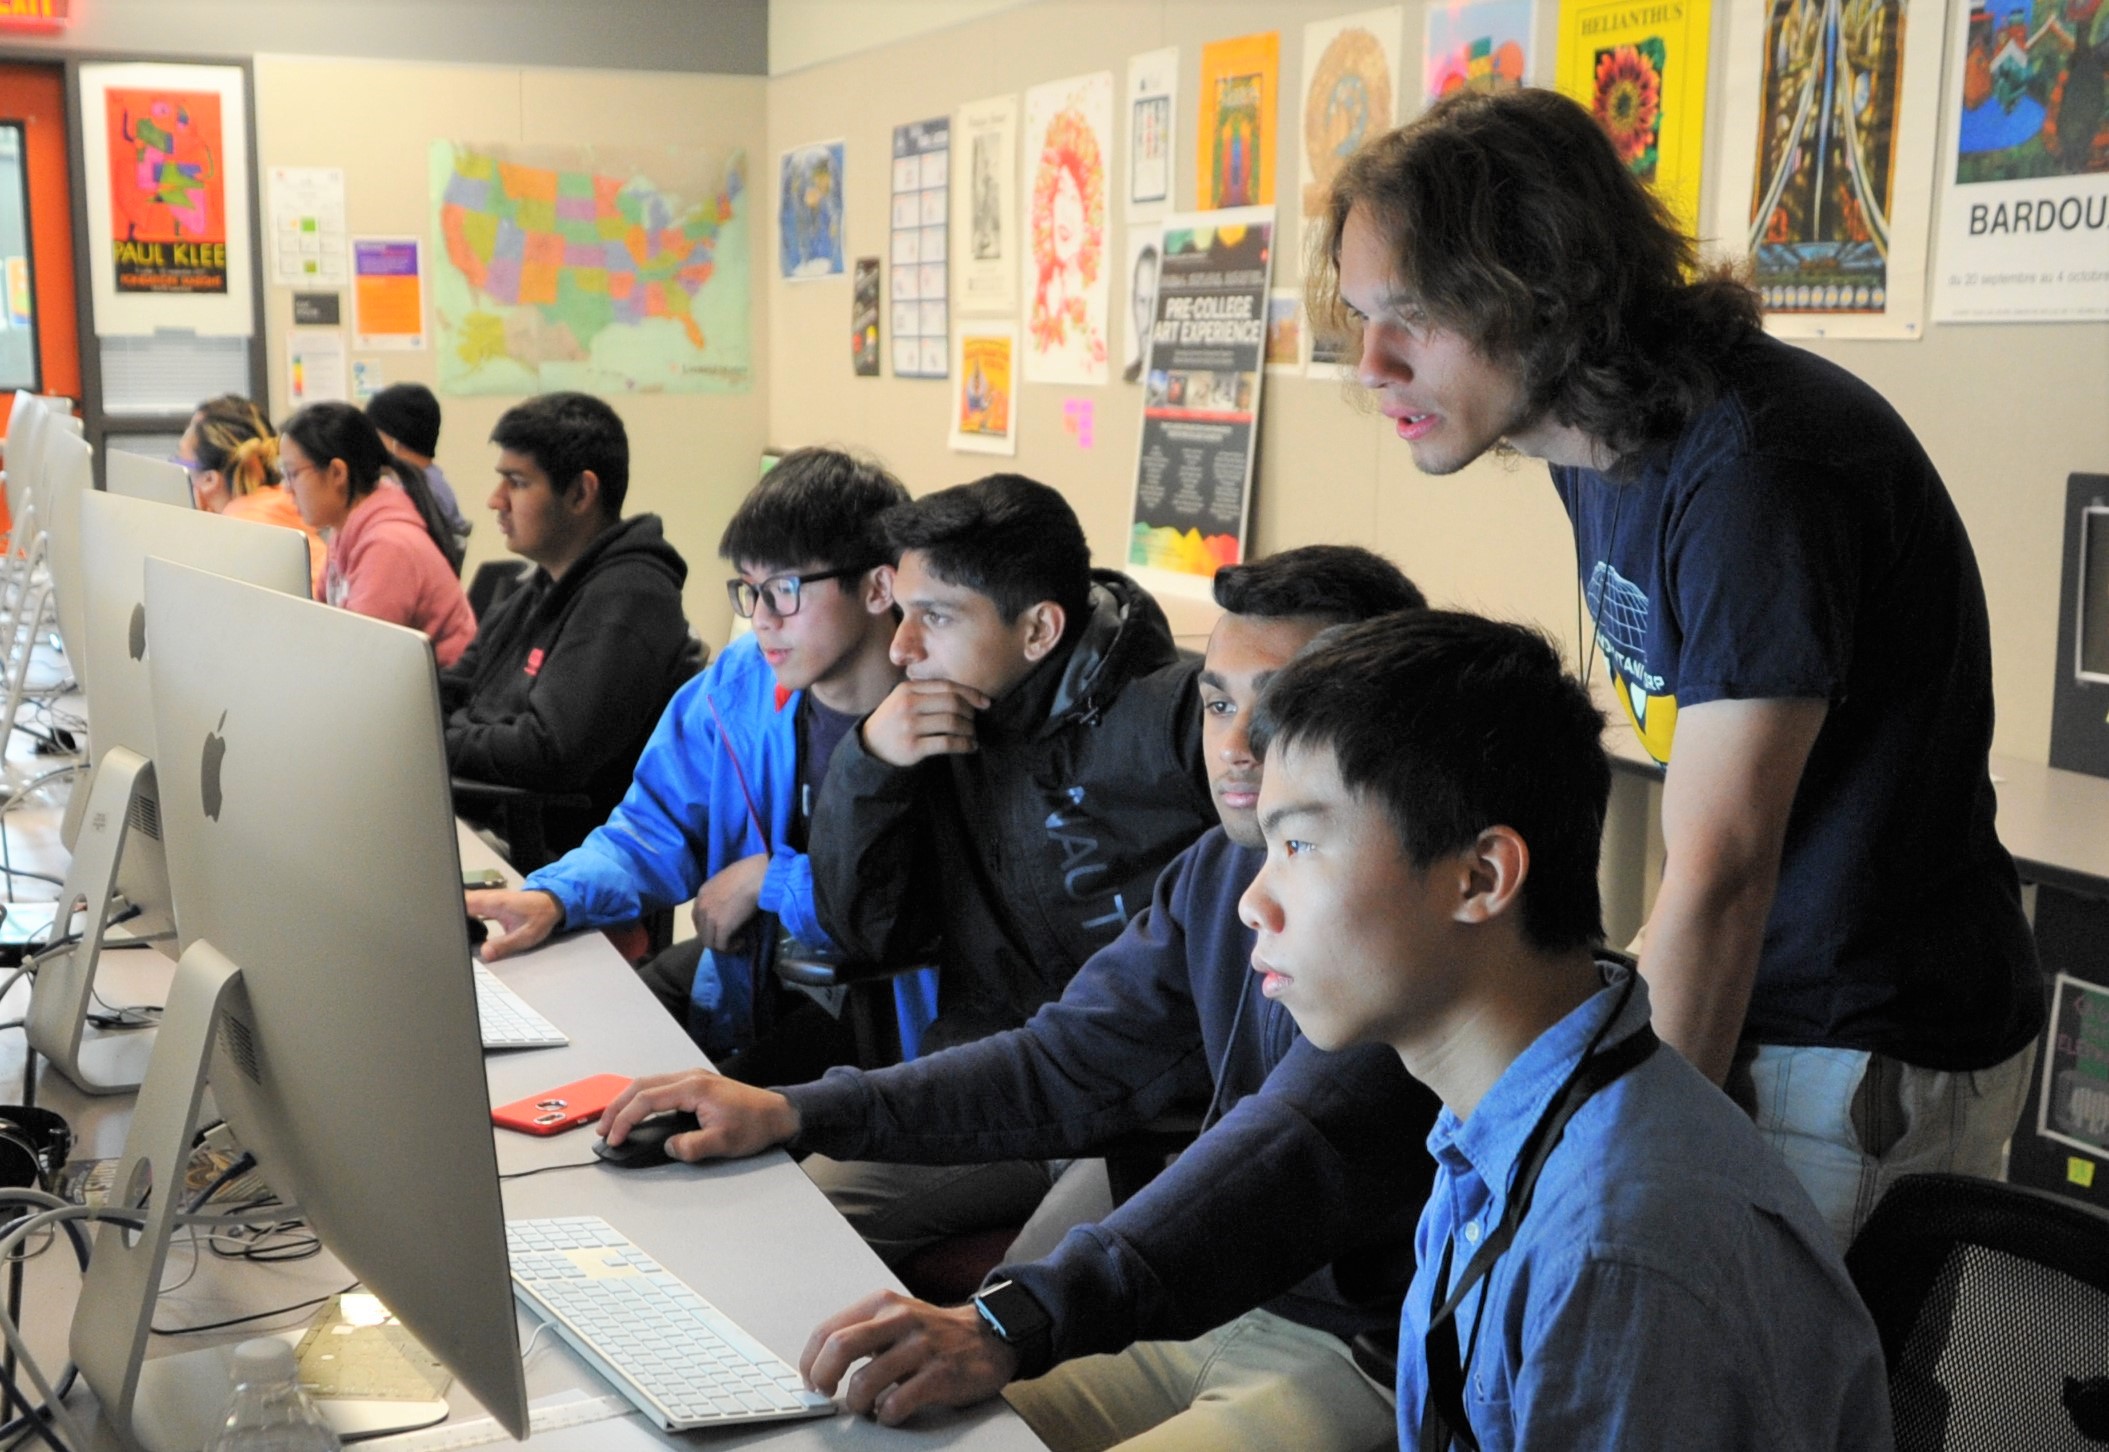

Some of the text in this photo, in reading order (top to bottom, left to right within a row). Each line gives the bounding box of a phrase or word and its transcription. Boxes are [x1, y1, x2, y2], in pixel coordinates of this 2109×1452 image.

[1581, 3, 1683, 36] HELIANTHUS
[1968, 194, 2109, 236] BARDOU
[113, 240, 226, 269] PAUL KLEE
[1981, 272, 2036, 288] septembre
[2056, 271, 2063, 282] 4
[1164, 295, 1254, 320] PRE-COLLEGE
[1153, 319, 1261, 346] ART EXPERIENCE
